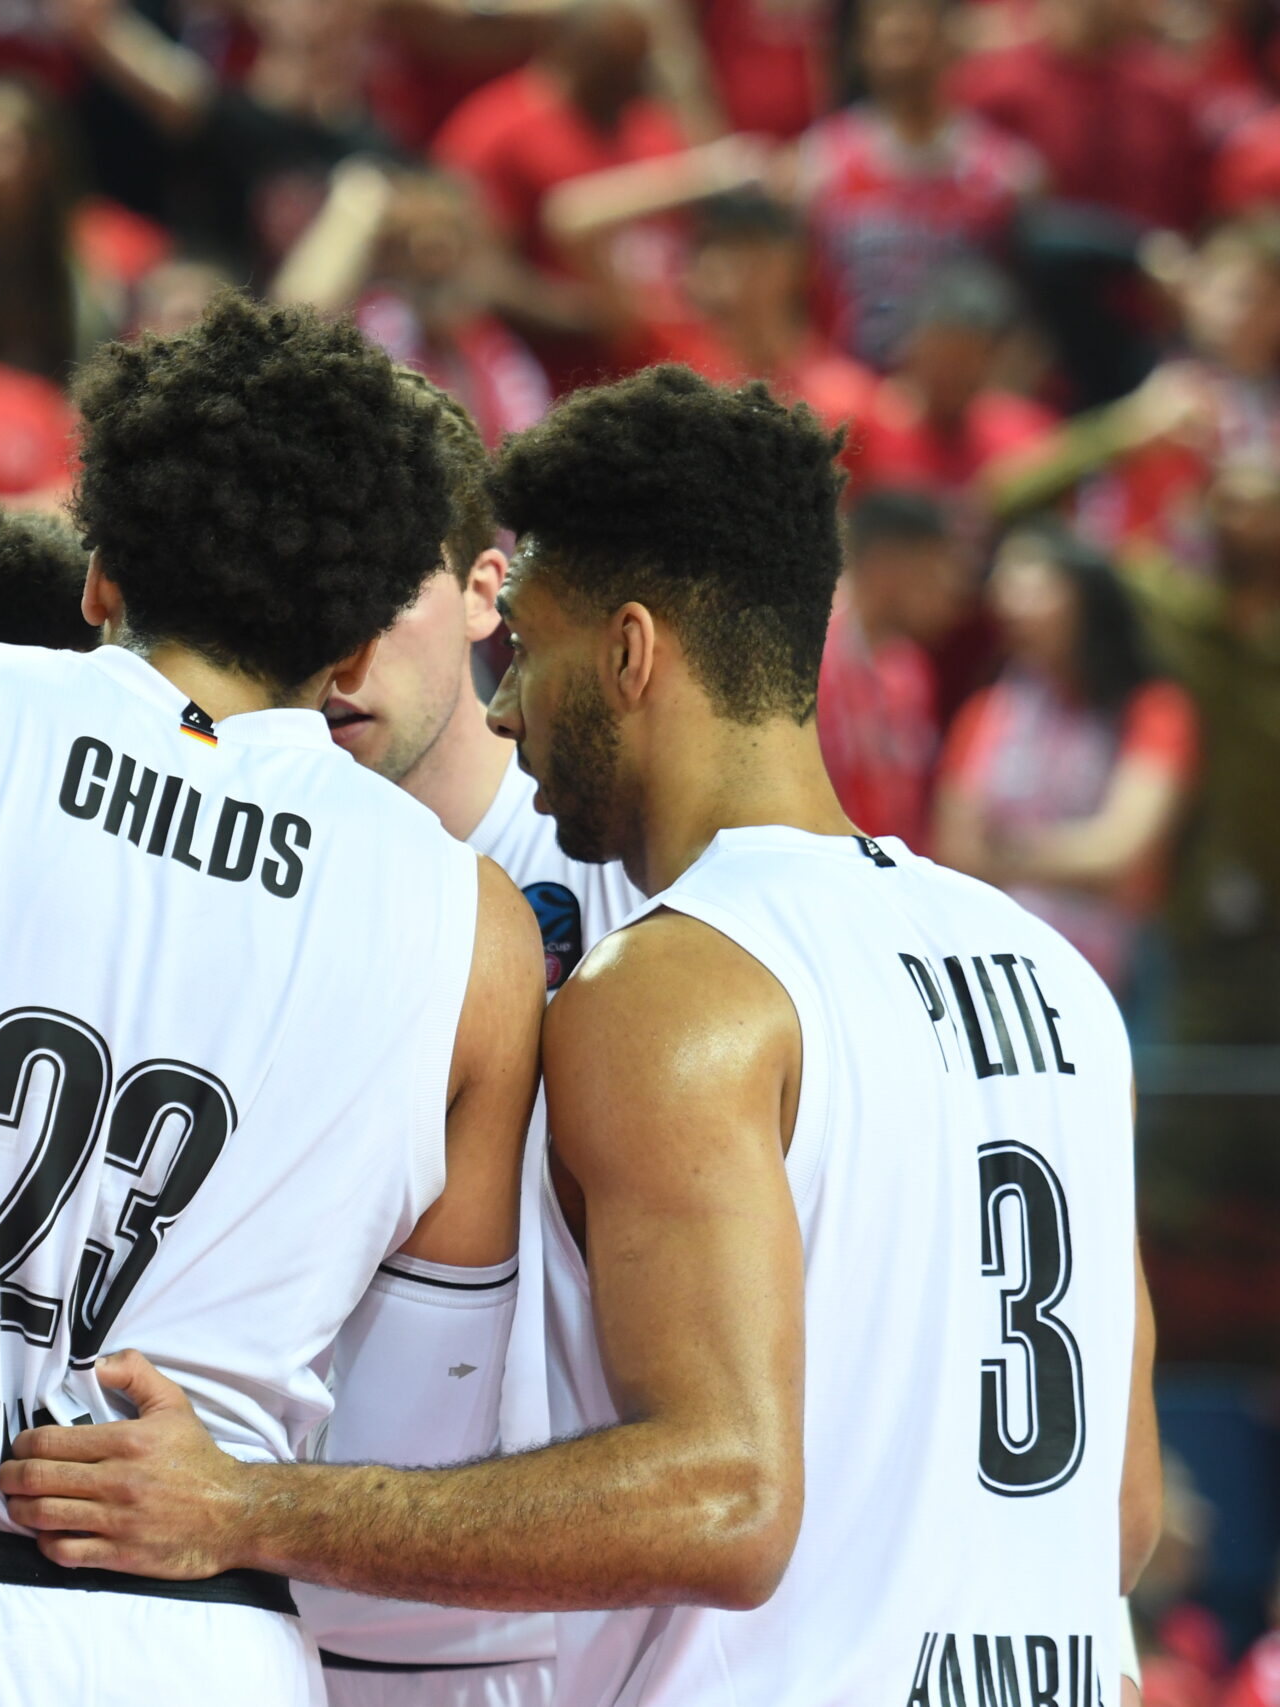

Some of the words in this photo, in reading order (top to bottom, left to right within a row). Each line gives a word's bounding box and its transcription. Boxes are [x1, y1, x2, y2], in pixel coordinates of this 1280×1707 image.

[59, 735, 312, 899] CHILDS
[897, 952, 1076, 1080] PLITE
[976, 1138, 1087, 1499] 3
[906, 1631, 1106, 1707] HAMBU
